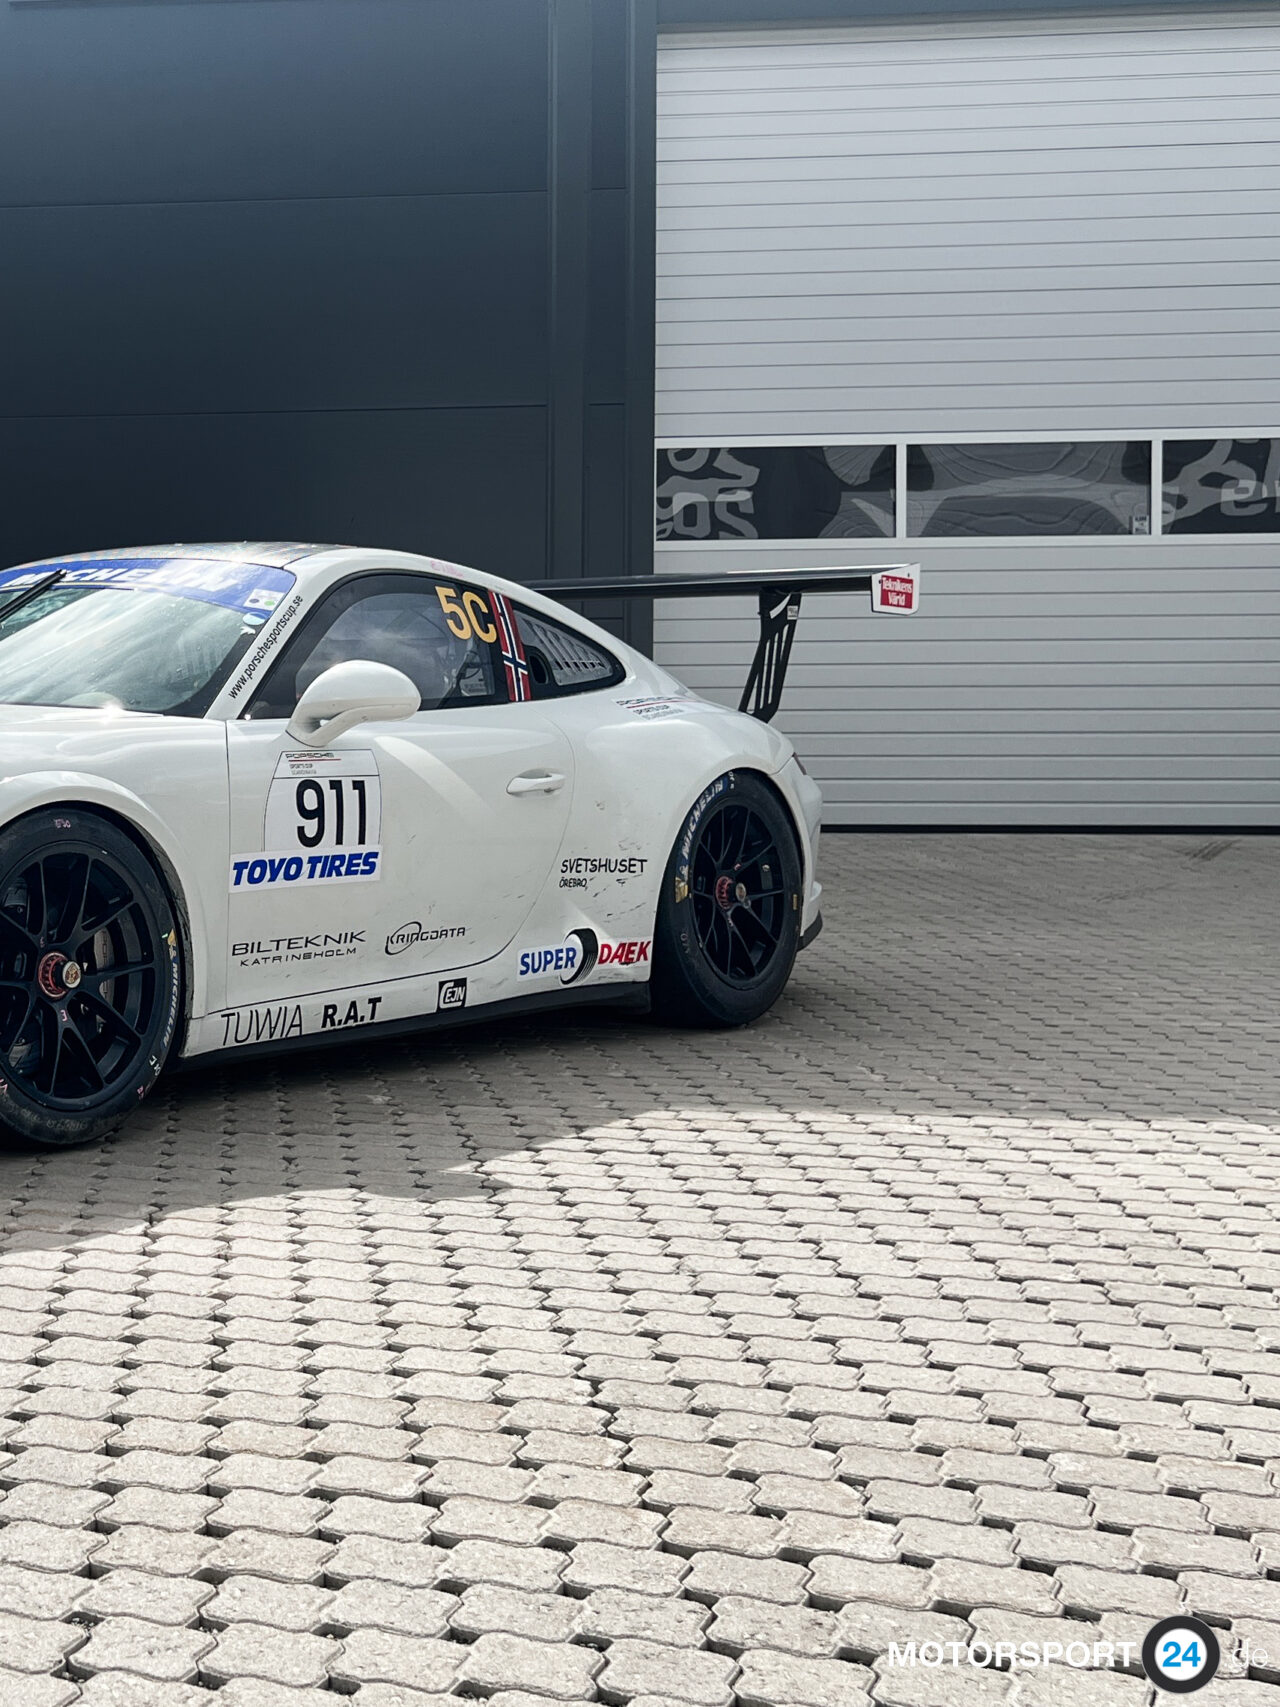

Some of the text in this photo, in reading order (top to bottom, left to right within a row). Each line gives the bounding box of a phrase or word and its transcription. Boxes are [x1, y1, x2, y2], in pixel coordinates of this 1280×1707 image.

[435, 586, 497, 643] 5C
[228, 595, 303, 699] www.porschesportscup.se
[296, 779, 366, 848] 911
[233, 852, 379, 886] TOYO TIRES
[560, 858, 648, 874] SVETSHUSET
[232, 930, 366, 956] BILTEKNIK
[240, 948, 356, 967] KATRINEHOLM
[520, 947, 577, 976] SUPER
[221, 997, 382, 1046] TUWIA R.A.T
